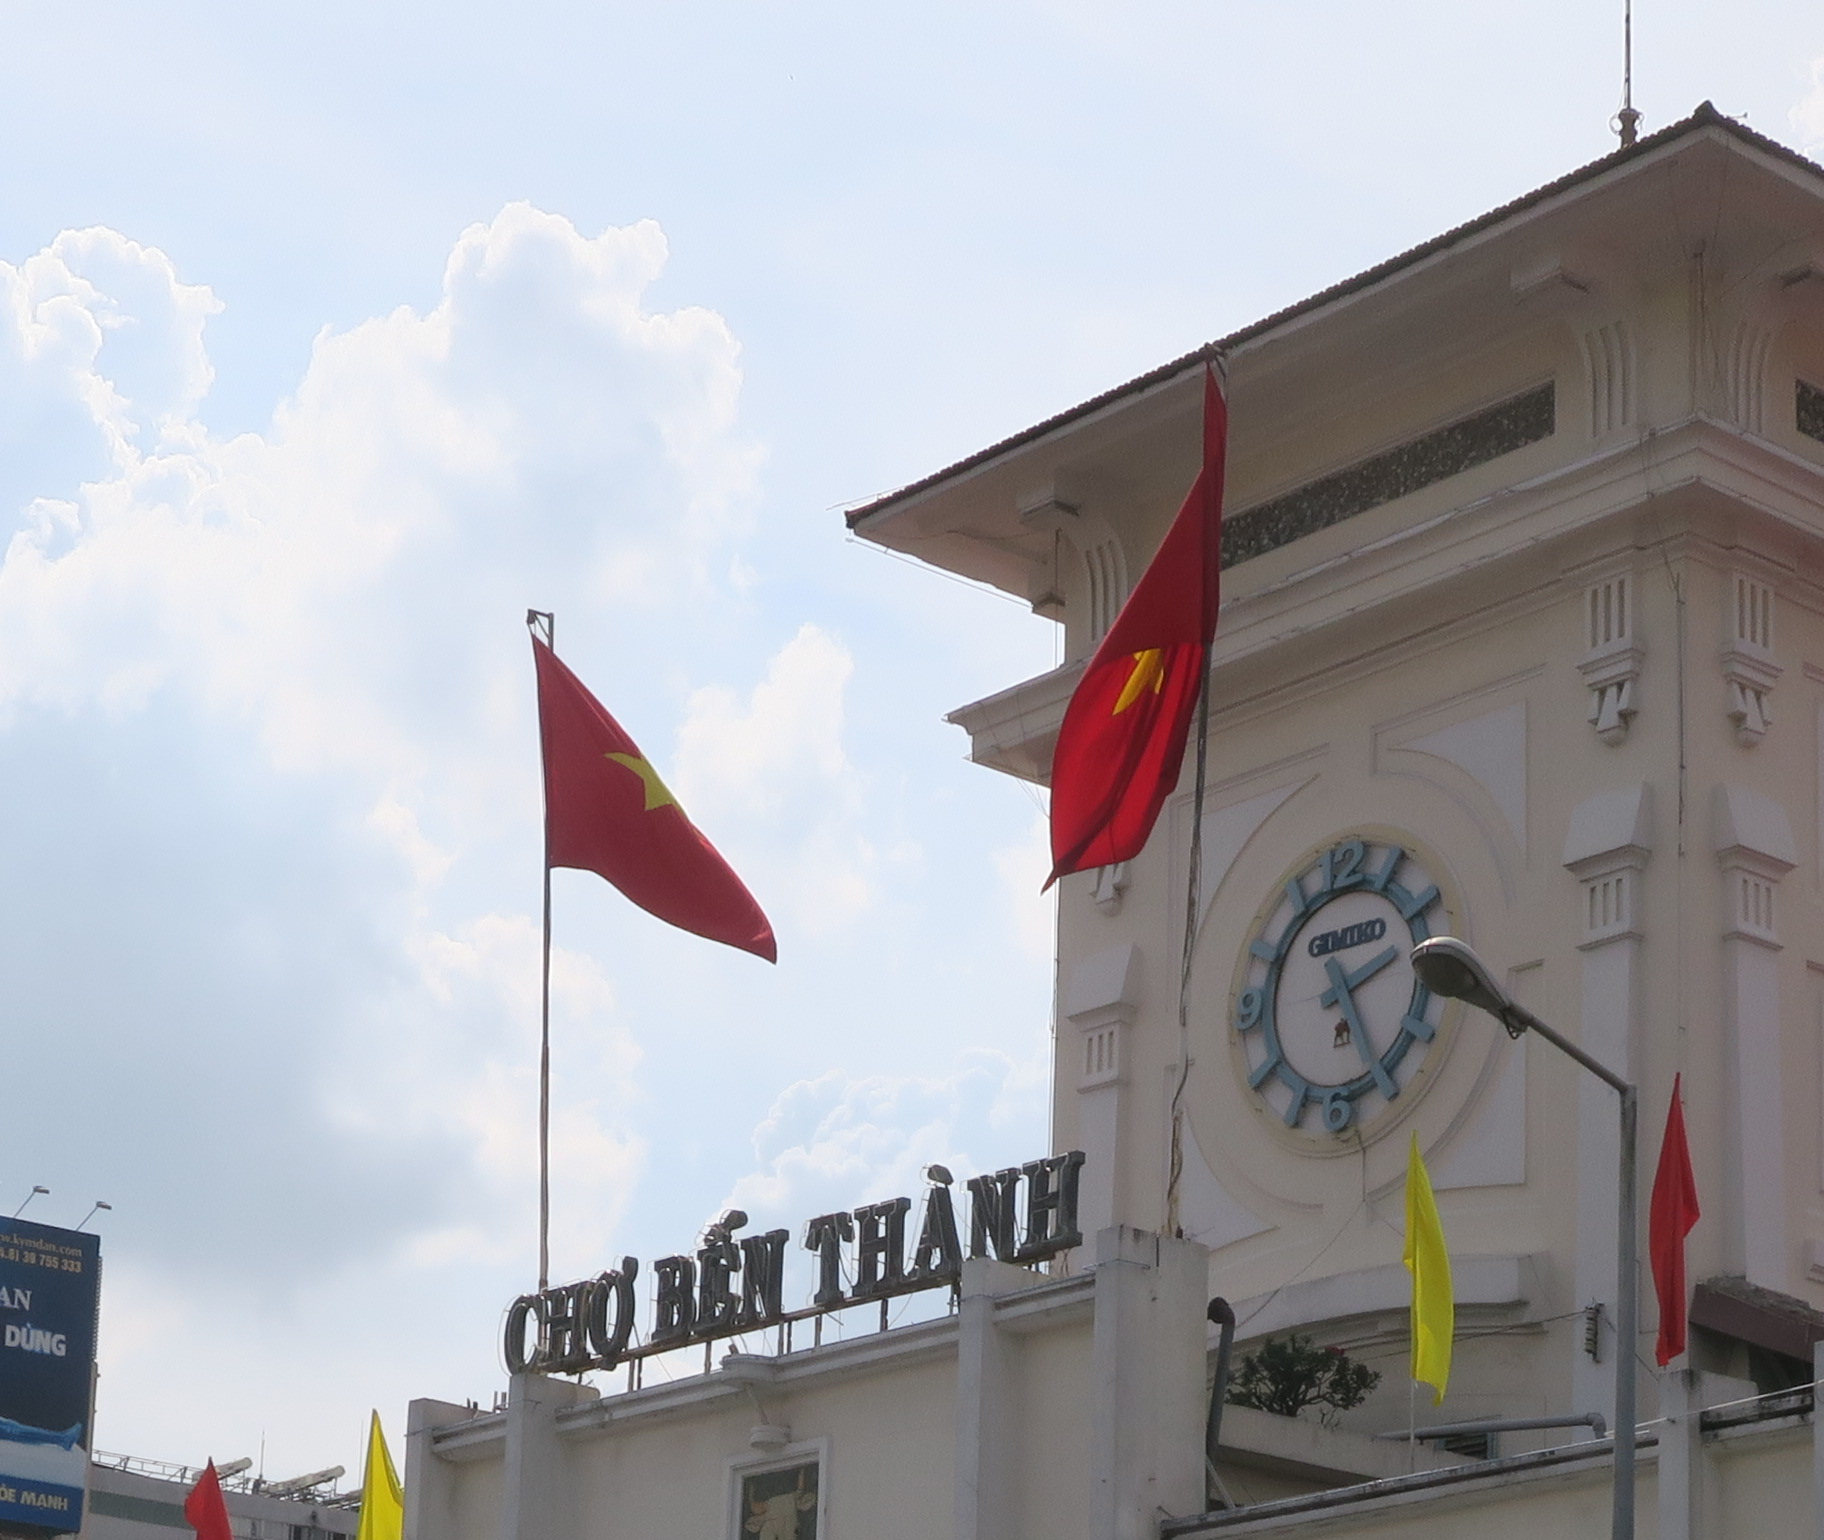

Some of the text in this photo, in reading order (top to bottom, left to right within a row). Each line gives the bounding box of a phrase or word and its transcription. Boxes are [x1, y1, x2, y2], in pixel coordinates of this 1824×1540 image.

[499, 1150, 1086, 1376] CHỢ BẾN THÀNH
[4, 1322, 67, 1357] DÙNG
[20, 1490, 69, 1512] MẠNH
